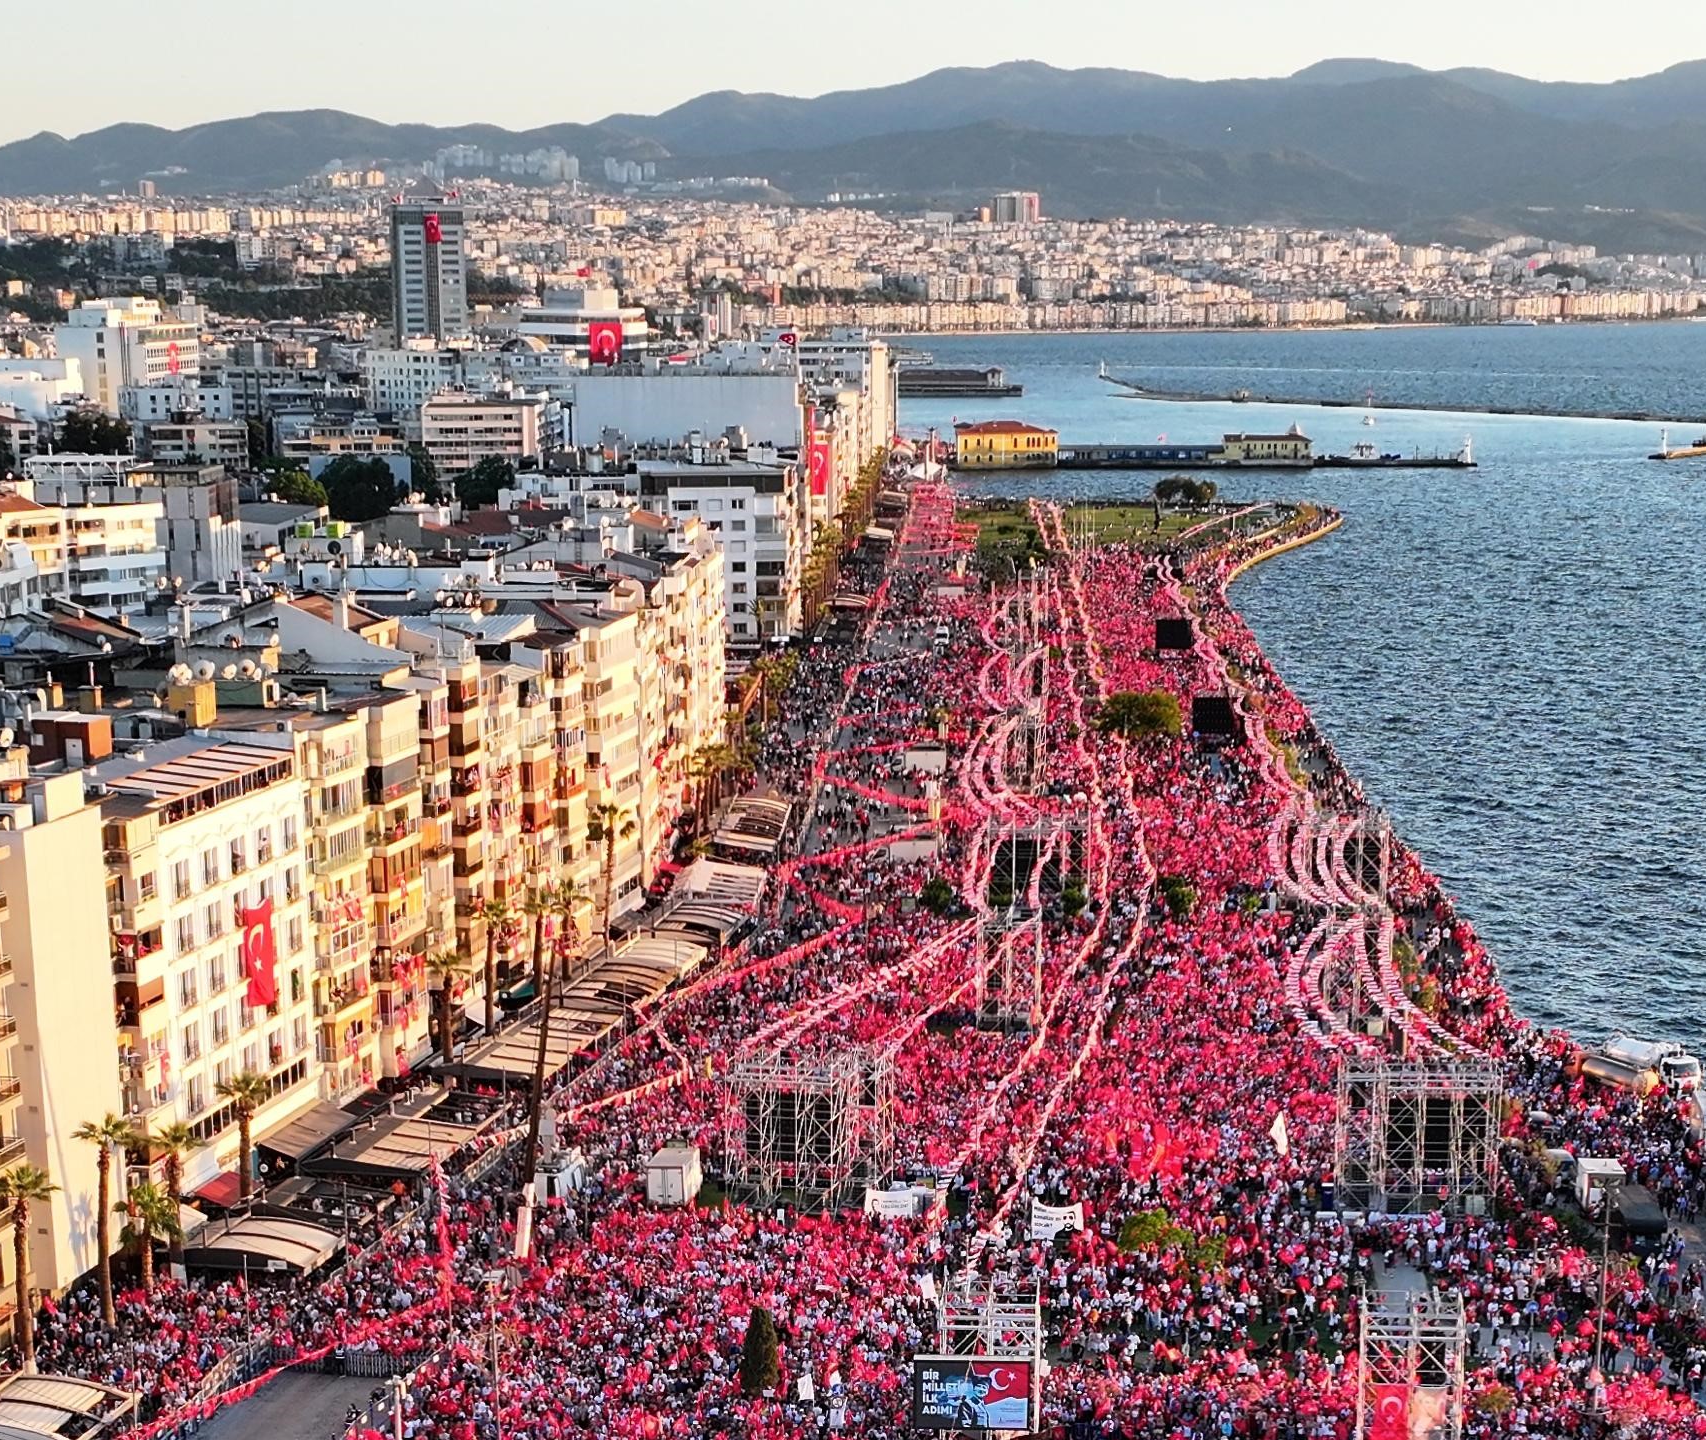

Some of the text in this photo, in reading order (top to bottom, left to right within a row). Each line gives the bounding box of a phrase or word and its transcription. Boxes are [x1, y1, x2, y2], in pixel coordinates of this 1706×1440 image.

[922, 1368, 939, 1380] BİR
[922, 1392, 939, 1403] İLK
[922, 1405, 953, 1415] ADIMI
